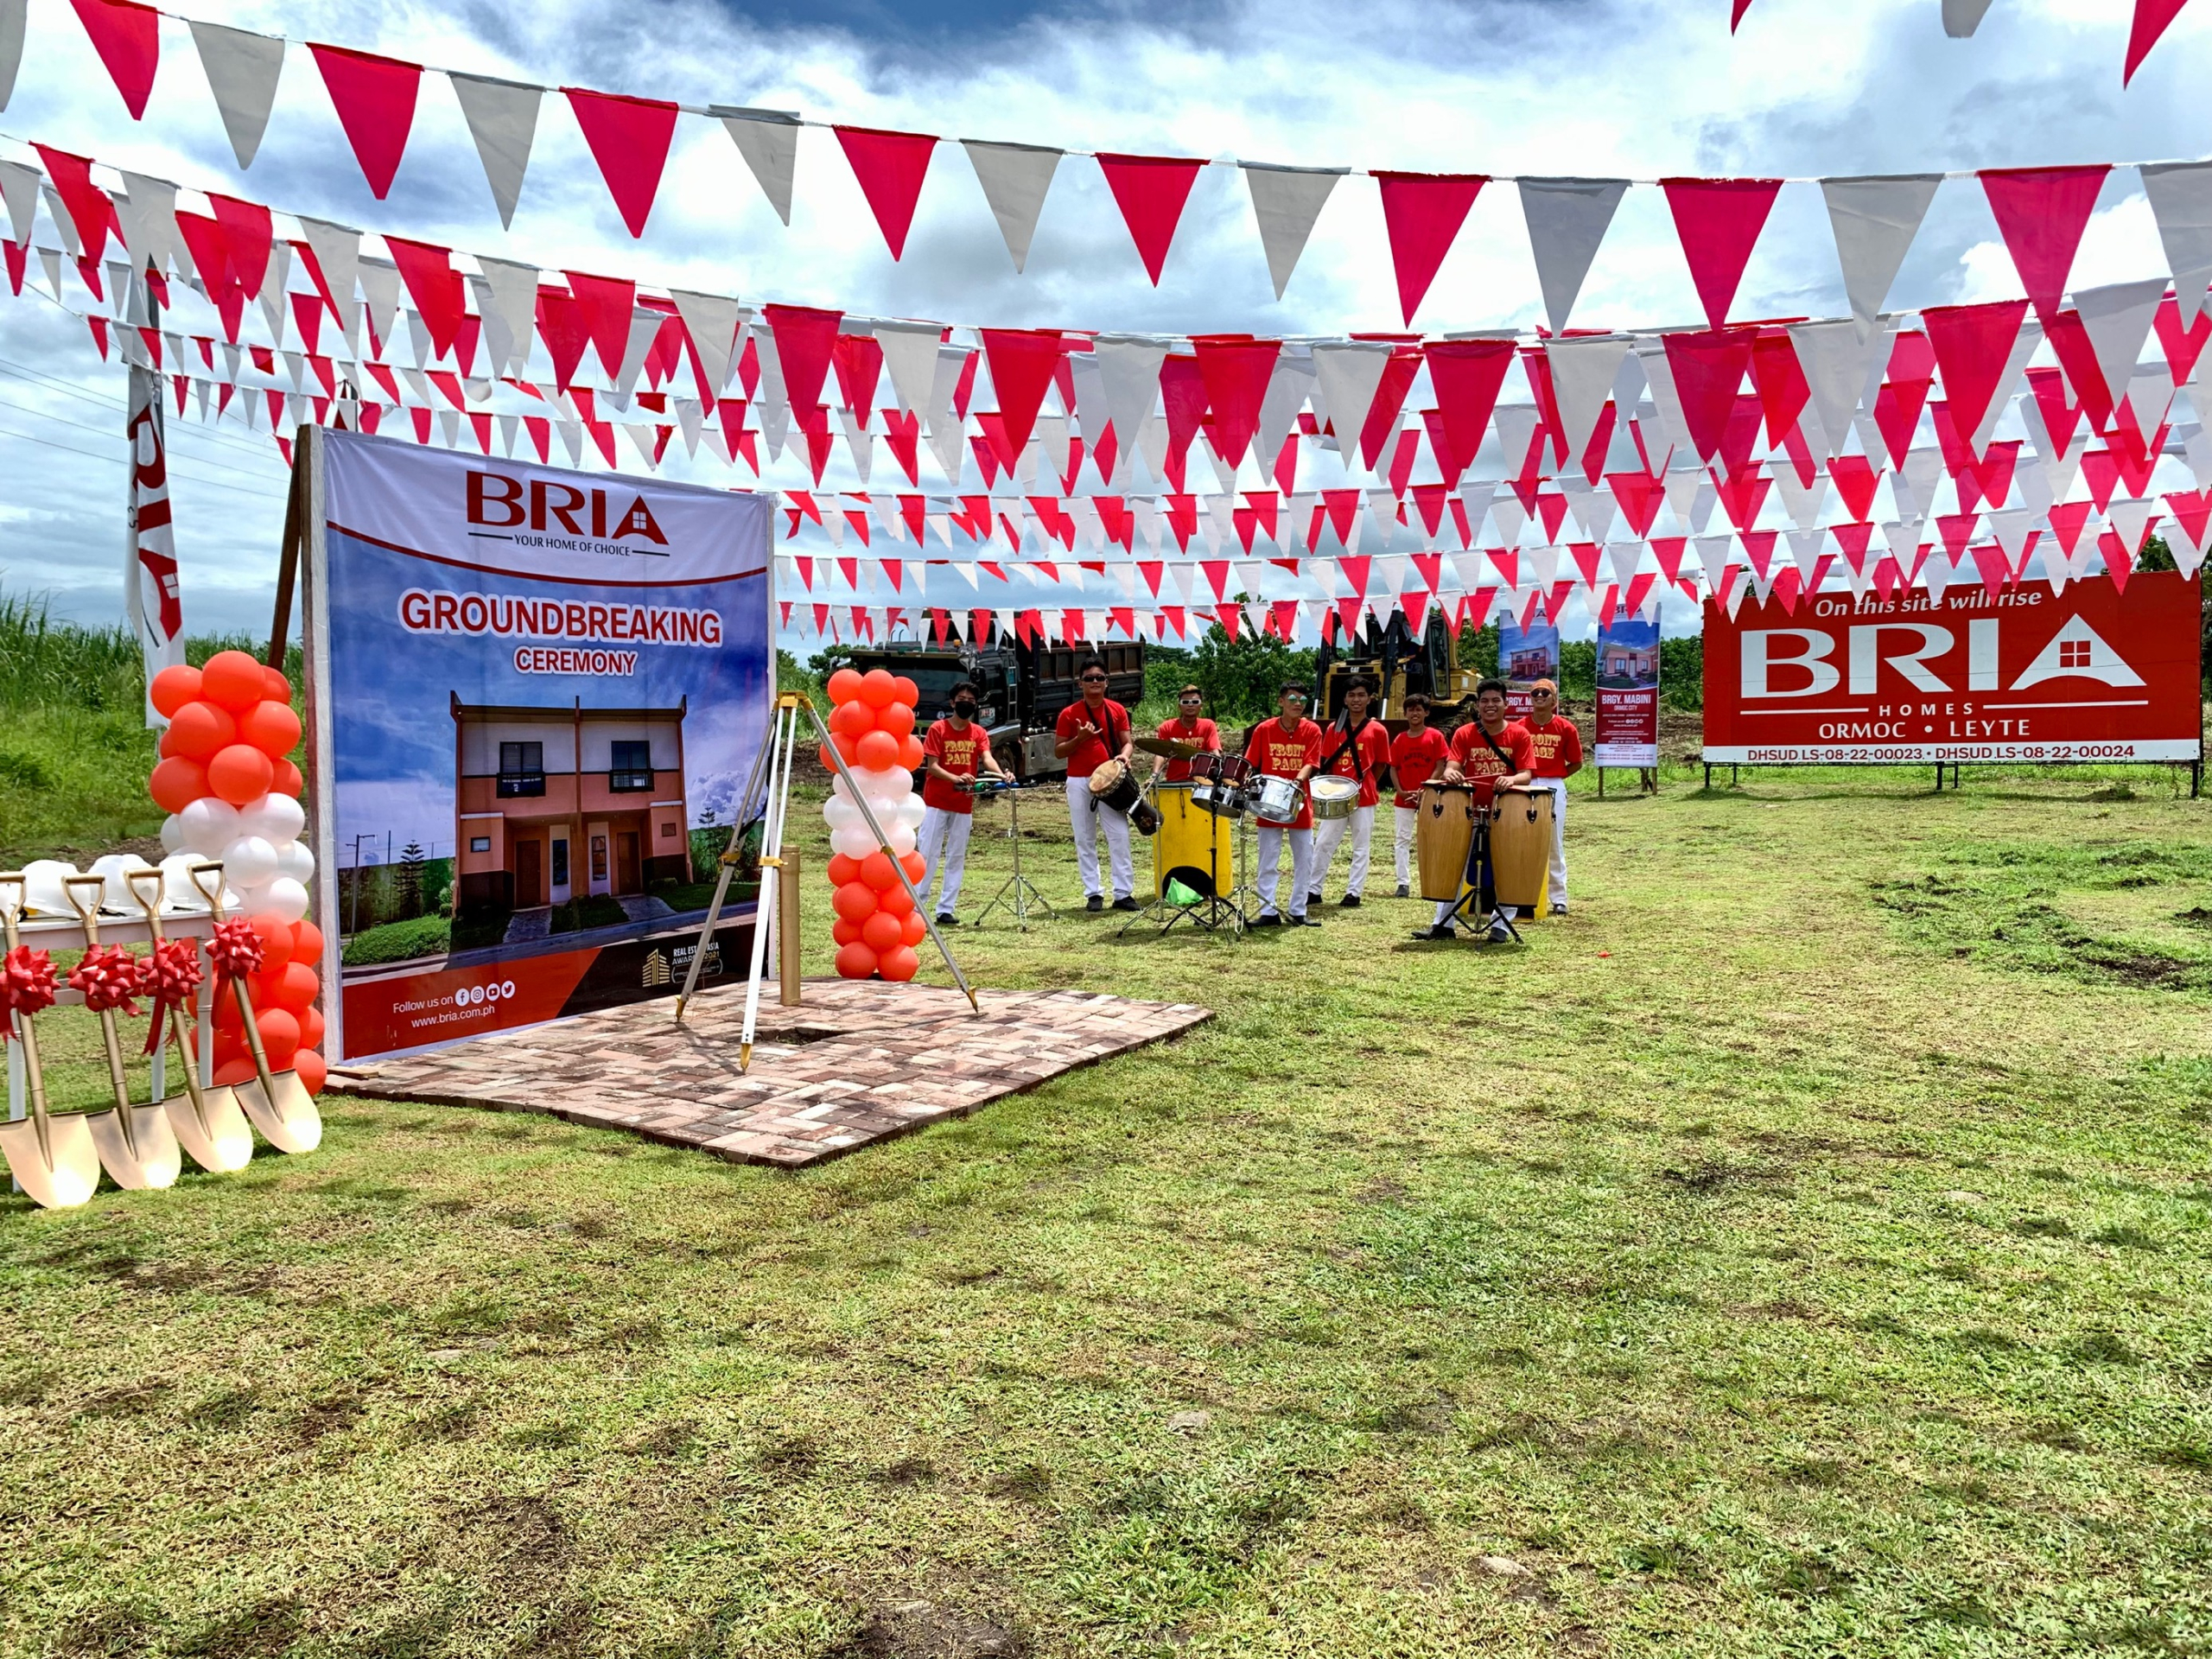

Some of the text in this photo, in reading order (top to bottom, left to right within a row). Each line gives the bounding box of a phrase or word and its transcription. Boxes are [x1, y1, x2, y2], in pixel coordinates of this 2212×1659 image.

[467, 470, 669, 545] BRIA
[514, 534, 631, 556] YOUR HOME OF CHOICE
[1815, 588, 2043, 617] On this site will rise
[401, 592, 722, 644] GROUNDBREAKING
[516, 648, 638, 676] CEREMONY
[1741, 613, 2147, 699] BRIA
[1506, 696, 1524, 706] RGY.
[1602, 694, 1651, 704] BRGY. MABINI
[1879, 702, 1973, 717] HOMES
[1818, 719, 2031, 740] ORMOC LEYTE
[1530, 734, 1561, 747] RONT
[1534, 746, 1555, 759] AGE
[1748, 745, 2136, 760] DHSUD LS-08-22-00023 DHSUD LS-08-22-00024
[672, 950, 720, 965] AWAR 2021
[673, 947, 687, 957] REAL
[393, 995, 454, 1014] Follow us on
[411, 1004, 495, 1028] www.bria.com.ph
